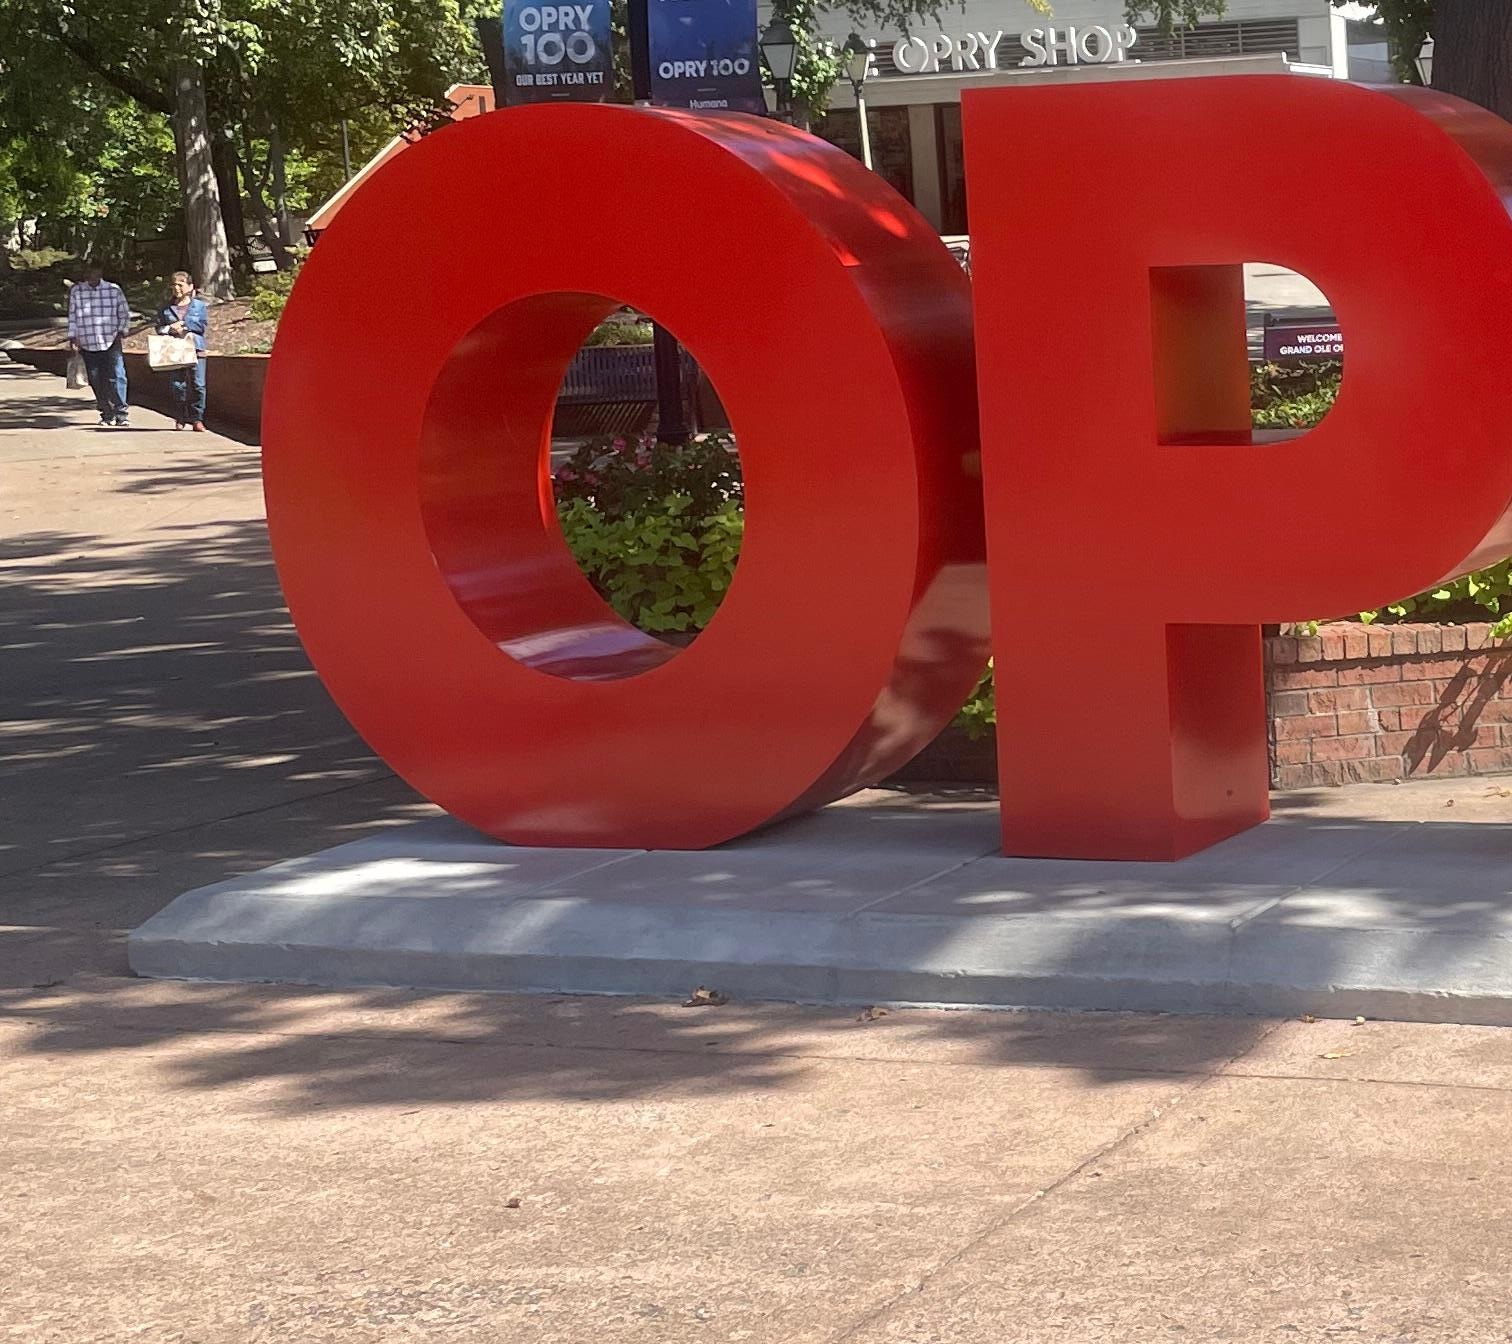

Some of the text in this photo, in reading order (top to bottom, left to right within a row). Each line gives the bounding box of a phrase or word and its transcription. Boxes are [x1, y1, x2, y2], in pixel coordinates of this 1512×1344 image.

[519, 4, 594, 32] OPRY
[520, 32, 596, 66] 100
[892, 30, 1003, 74] OPRY
[1019, 24, 1137, 66] SHOP
[659, 58, 750, 79] OPRY 100
[516, 71, 604, 86] OUR BEST YEAR YET
[689, 99, 728, 109] Humana
[1297, 333, 1343, 343] WELCOME
[1280, 345, 1313, 355] GRAND
[1314, 344, 1332, 354] OLE
